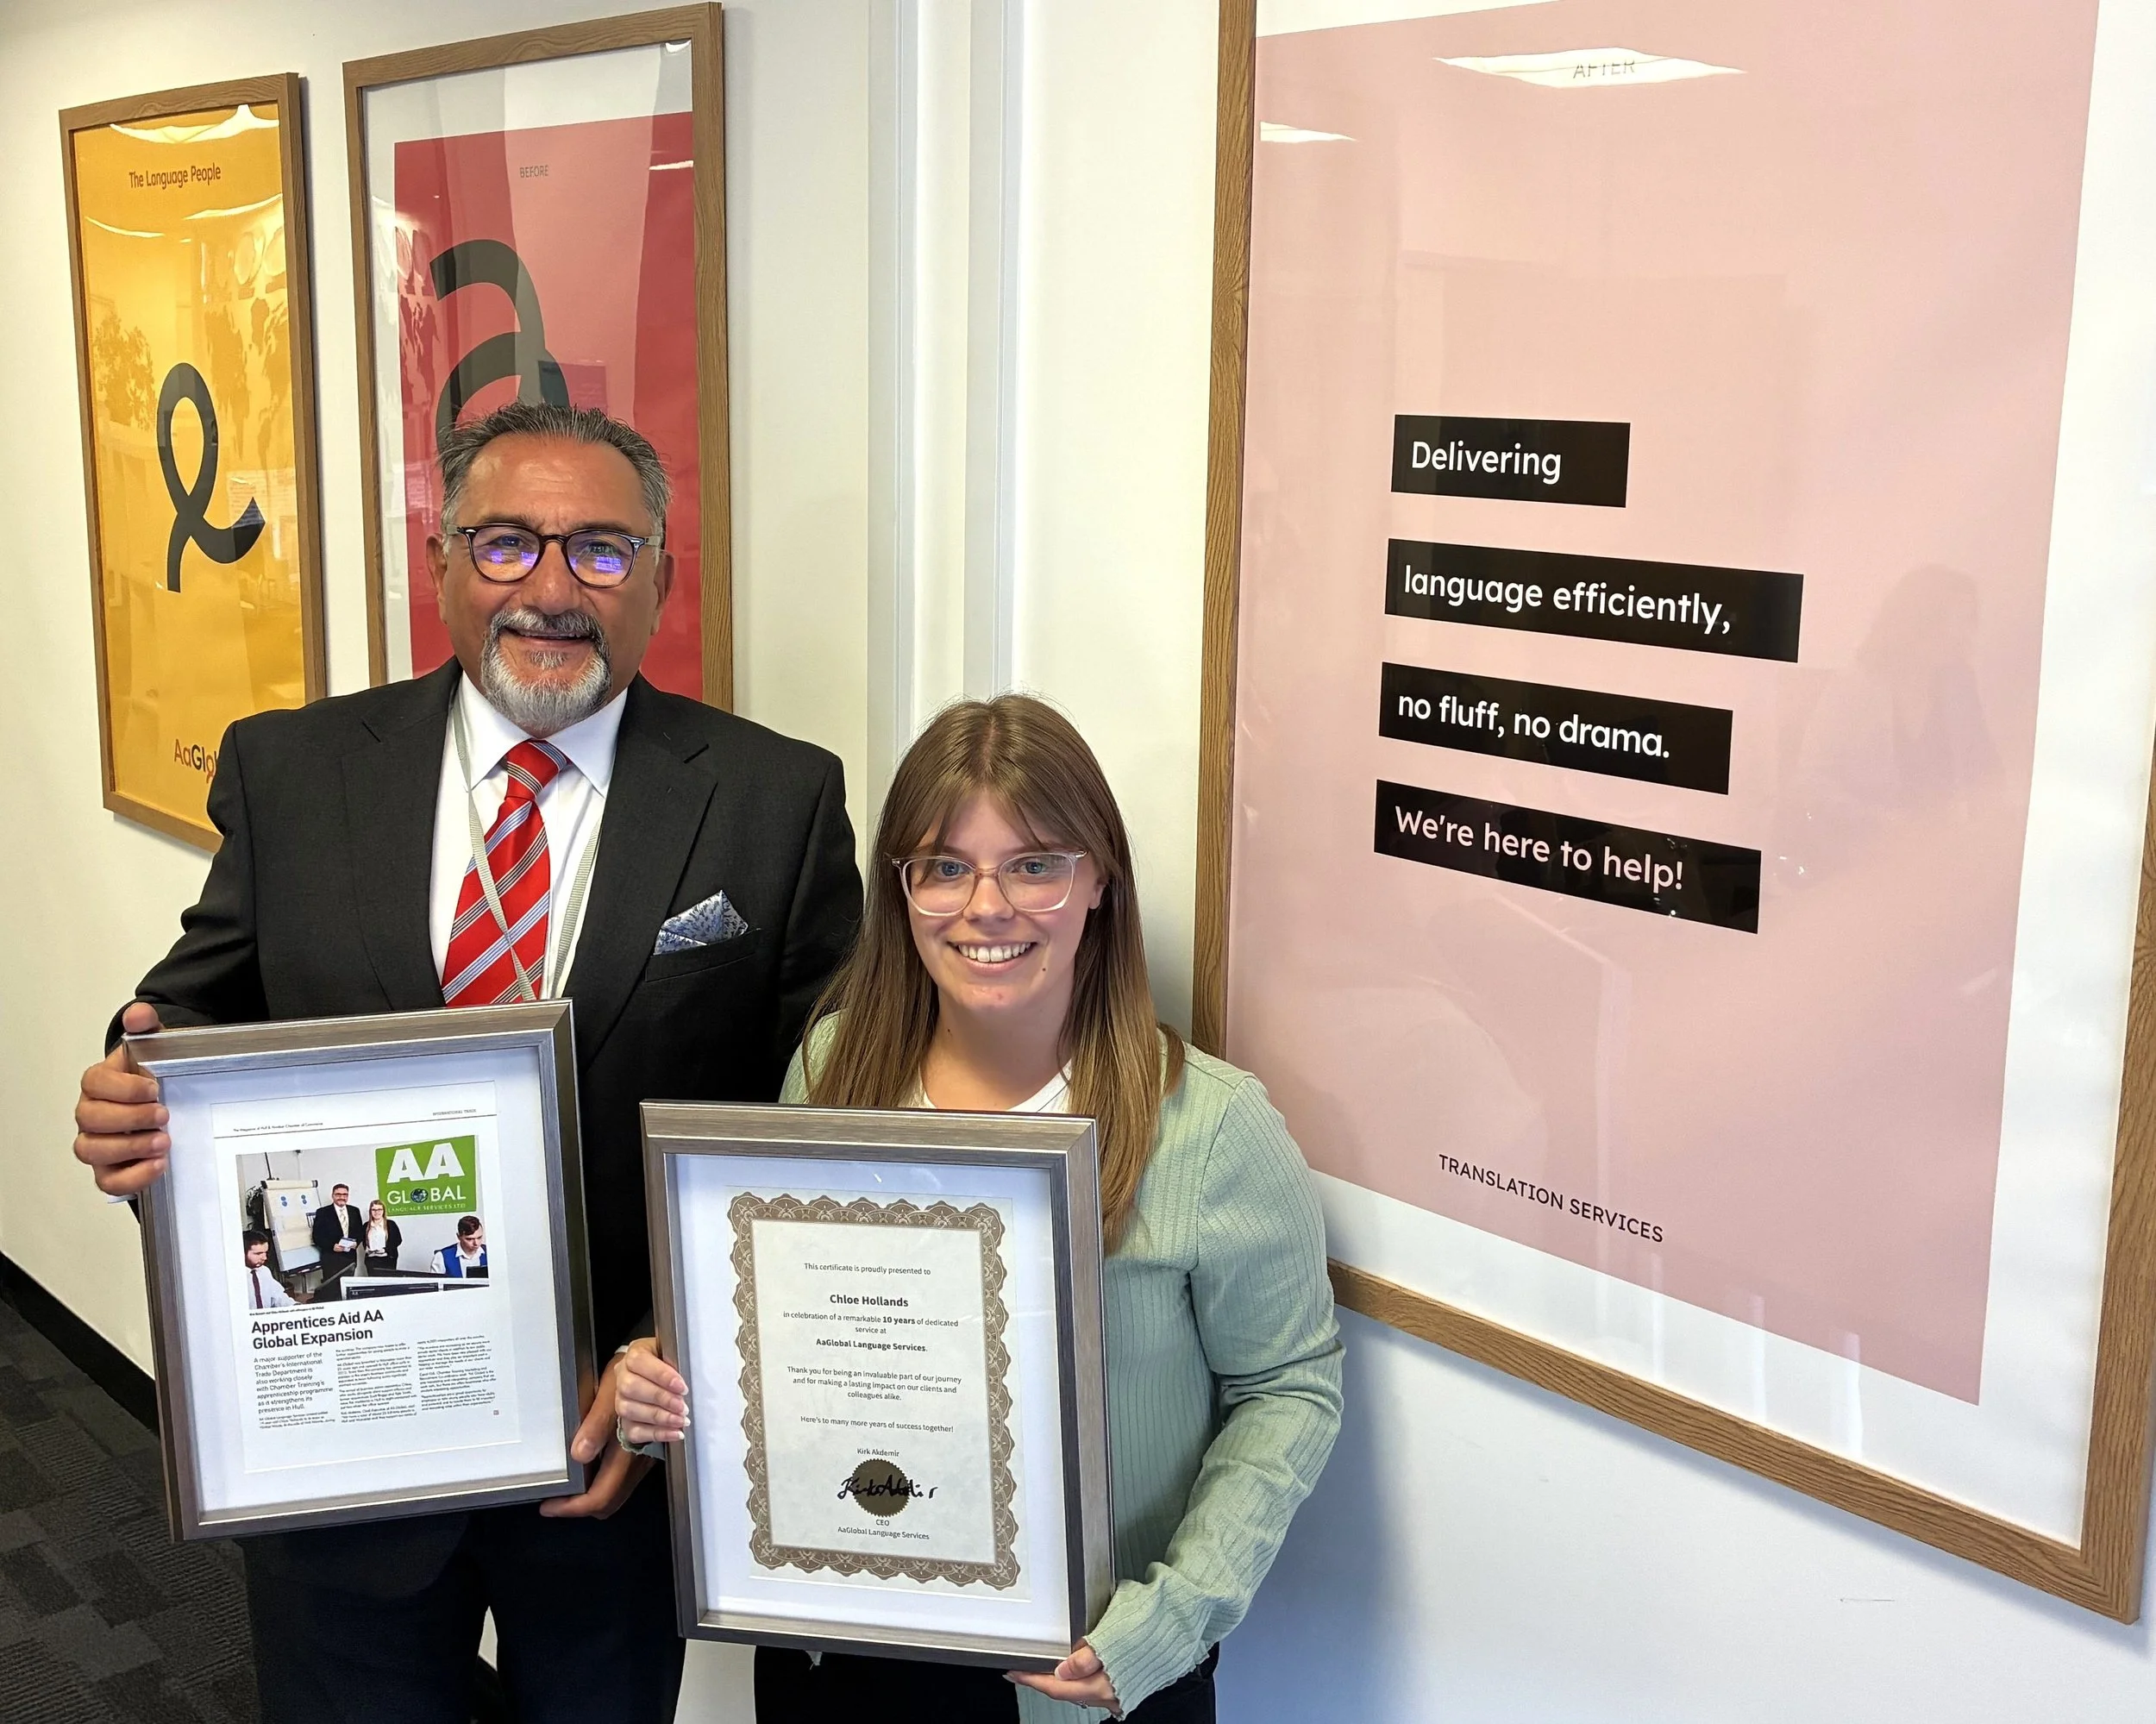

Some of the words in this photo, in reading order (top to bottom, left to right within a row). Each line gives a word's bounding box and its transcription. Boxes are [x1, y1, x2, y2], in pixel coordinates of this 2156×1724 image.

[128, 171, 144, 188] The
[146, 170, 188, 190] Language
[191, 162, 221, 185] People
[519, 165, 549, 178] BEFORE
[1412, 441, 1562, 485] Delivering
[1404, 565, 1543, 612] language
[1552, 581, 1731, 635] efficiently,
[1398, 695, 1432, 719] no
[1439, 695, 1505, 738] fluff,
[1514, 712, 1551, 738] no
[1559, 714, 1670, 758] drama.
[1395, 806, 1474, 846] We're
[1483, 823, 1551, 862] here
[1560, 841, 1592, 871] to
[1603, 846, 1683, 893] help!
[386, 1142, 465, 1184] AA
[1438, 1154, 1564, 1210] TRANSLATION
[1570, 1198, 1664, 1243] SERVICES
[861, 1266, 887, 1275] proudly
[830, 1295, 860, 1304] Chloe
[862, 1296, 909, 1307] Hollands
[252, 1316, 335, 1335] Apprentices
[338, 1311, 360, 1326] Aid
[363, 1309, 384, 1323] AA
[253, 1334, 298, 1350] Global
[301, 1328, 373, 1346] Expansion
[816, 1338, 852, 1347] AaGlobal
[853, 1340, 891, 1351] Language
[893, 1343, 928, 1351] Services.
[273, 1368, 307, 1376] Department
[833, 1369, 852, 1377] being
[935, 1375, 962, 1384] journey
[818, 1379, 843, 1388] making
[849, 1381, 872, 1389] lasting
[872, 1382, 895, 1390] impact
[848, 1391, 882, 1400] colleagues
[923, 1424, 954, 1432] together!
[868, 1529, 901, 1539] Language
